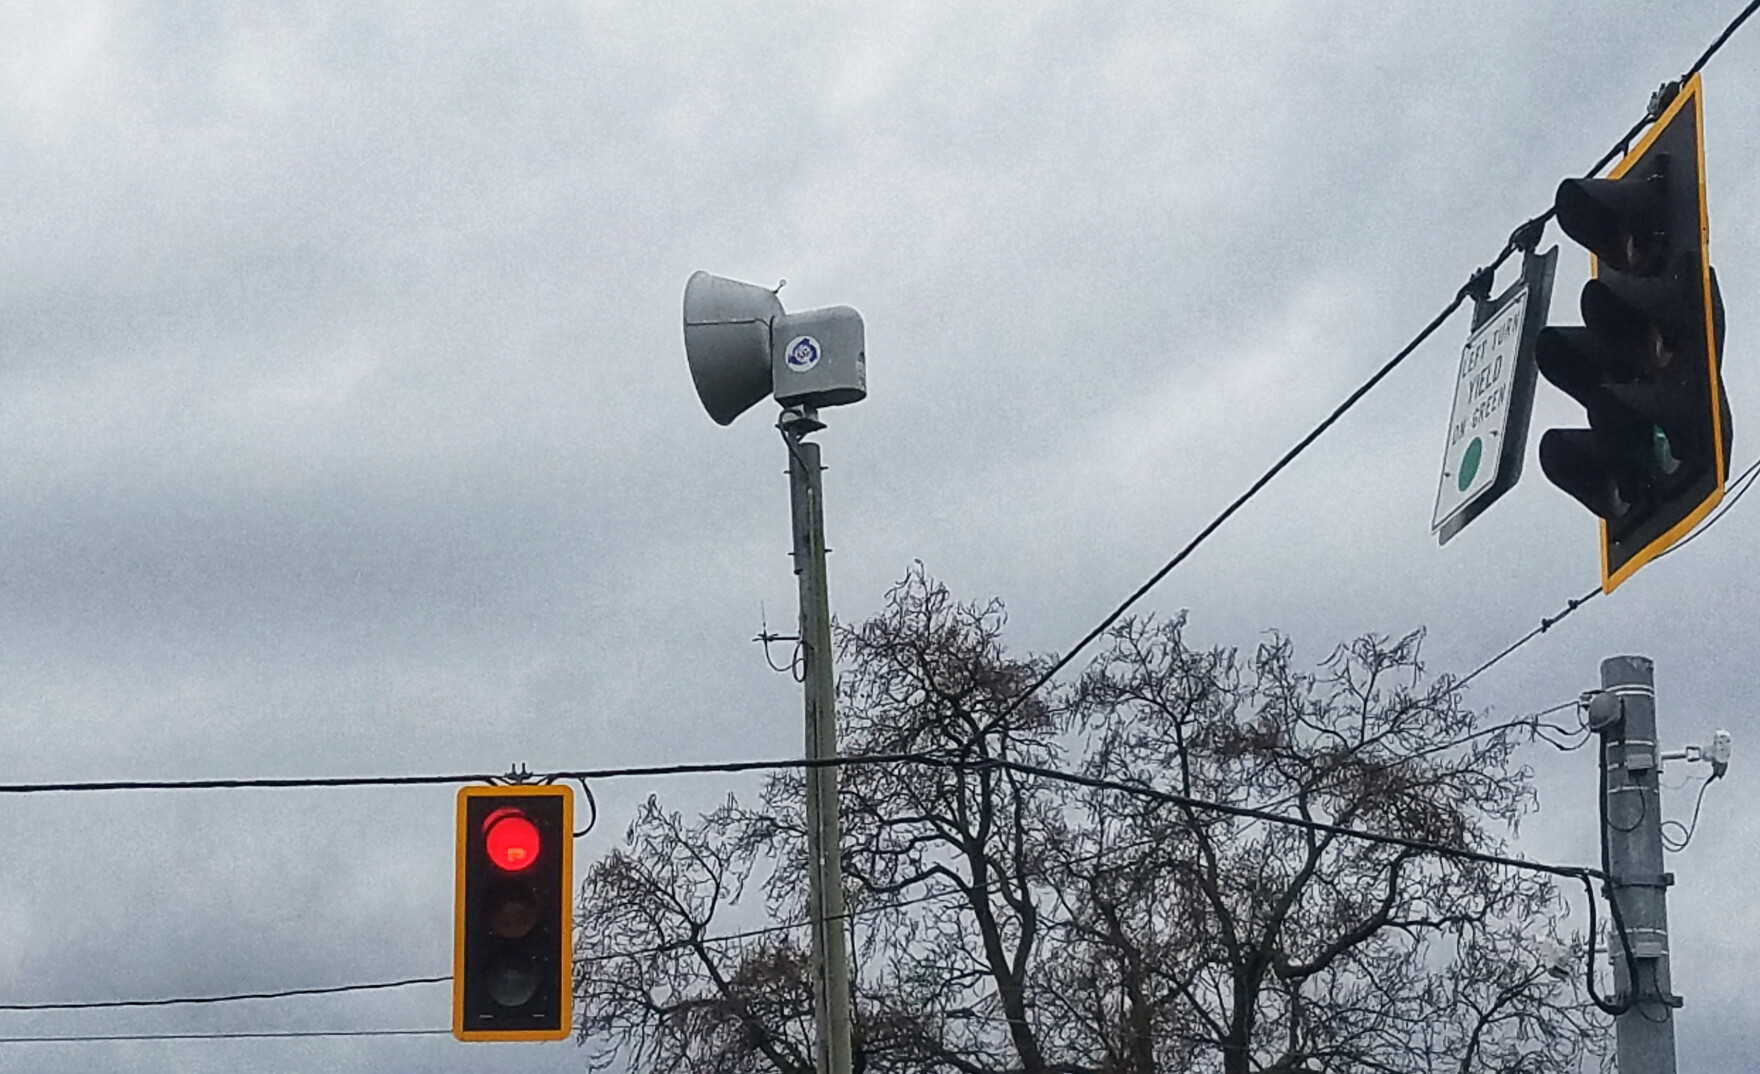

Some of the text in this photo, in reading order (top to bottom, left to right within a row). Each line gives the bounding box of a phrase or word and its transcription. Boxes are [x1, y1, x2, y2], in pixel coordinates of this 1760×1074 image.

[1462, 311, 1520, 378] LEFT TURN
[1468, 355, 1503, 405] YIELD
[1452, 382, 1506, 445] ON GREEN
